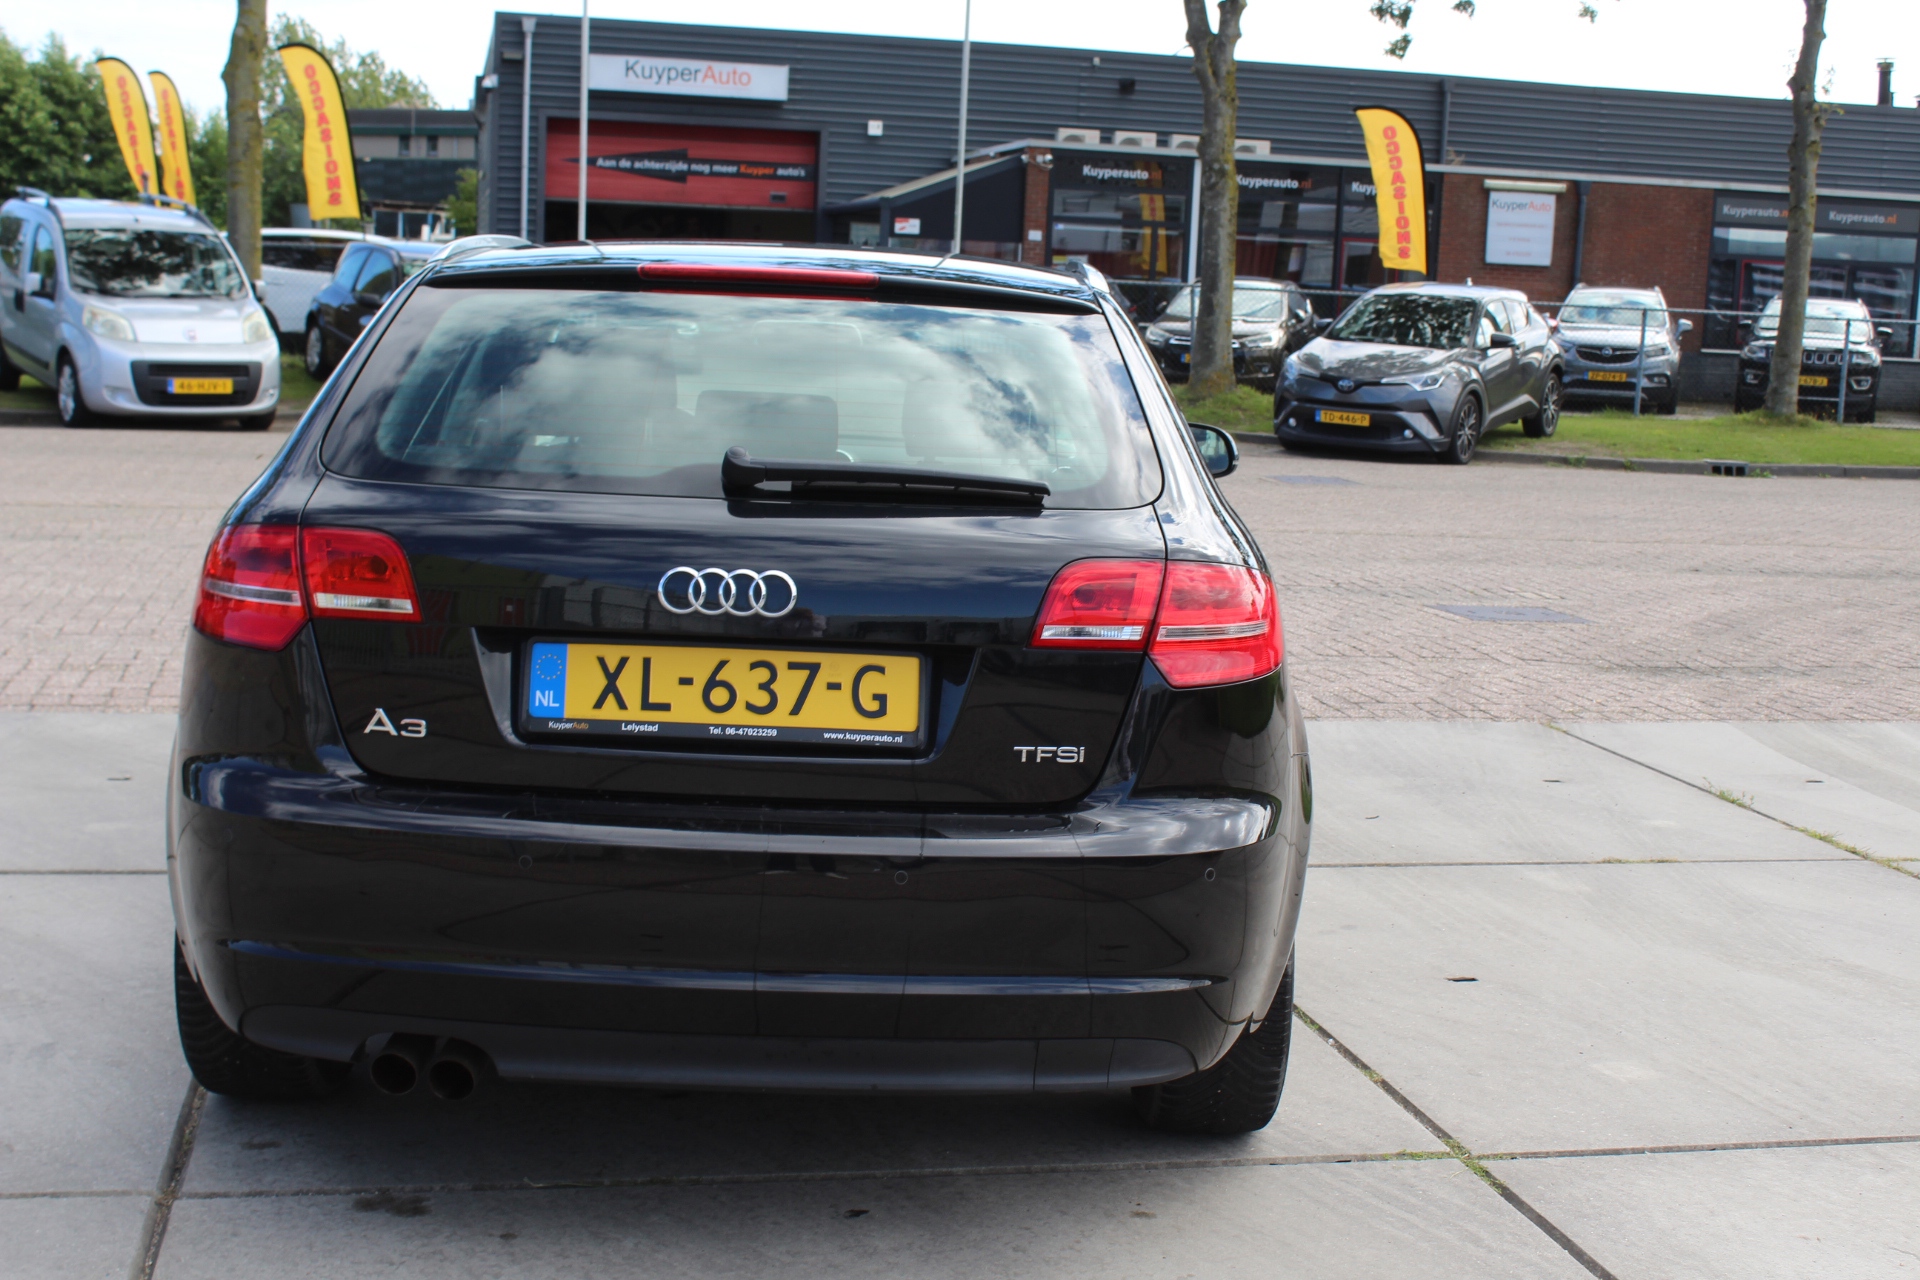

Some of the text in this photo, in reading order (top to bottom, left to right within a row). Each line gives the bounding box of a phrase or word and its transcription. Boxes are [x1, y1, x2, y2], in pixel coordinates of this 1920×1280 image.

[624, 59, 752, 87] KuyperAuto
[596, 157, 806, 177] Aan de achterzijde nog meer Kuyper auto's
[1491, 199, 1552, 213] KuyperAuto
[1828, 210, 1897, 224] Kuyperauto.nl
[1323, 412, 1367, 424] TD-446-P
[592, 656, 888, 719] XL-637-G
[534, 689, 560, 707] NL
[363, 707, 427, 738] A3
[548, 720, 903, 743] KuyperAuto Lelystad Tel. 06-47023259 www.kuyperauto.nl
